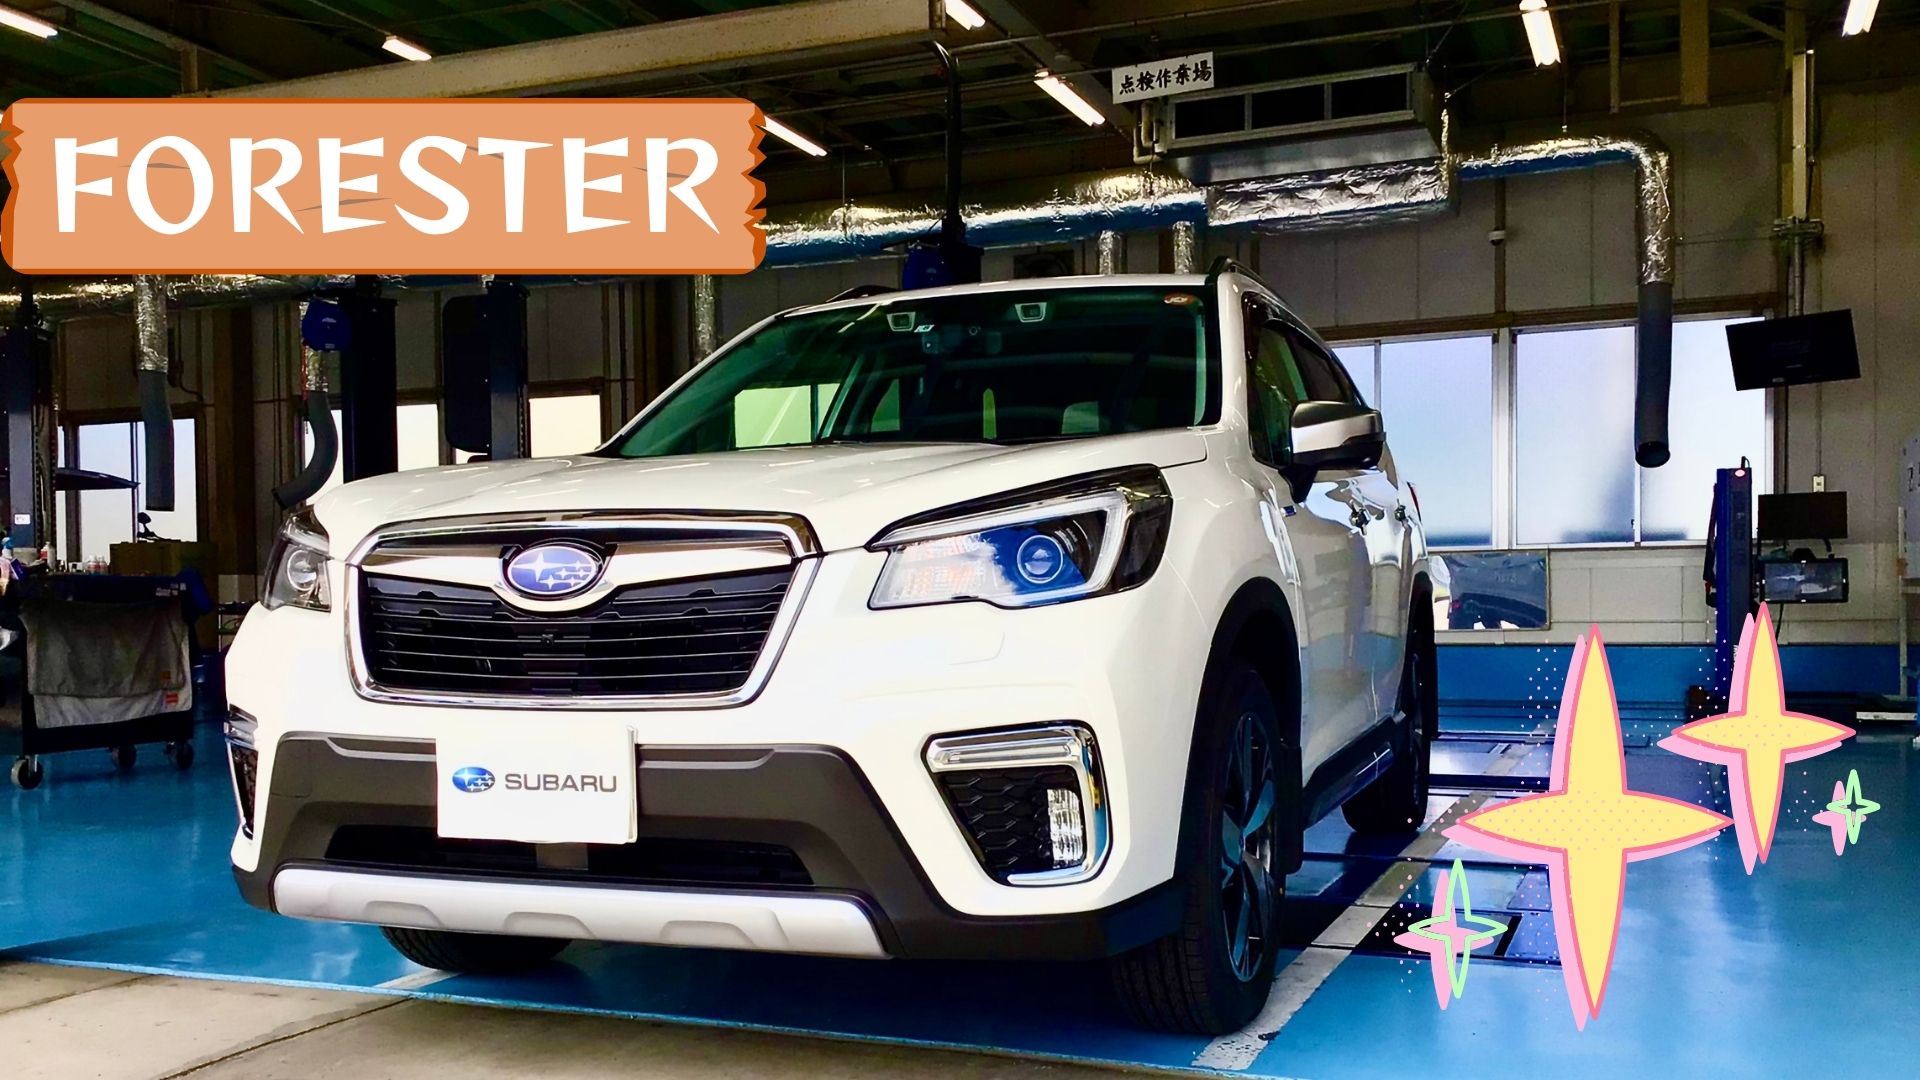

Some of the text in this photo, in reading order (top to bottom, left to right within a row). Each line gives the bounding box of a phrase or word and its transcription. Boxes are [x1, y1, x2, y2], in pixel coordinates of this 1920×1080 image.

[1119, 60, 1212, 95] 点検作業場
[505, 774, 617, 792] SUBARU
